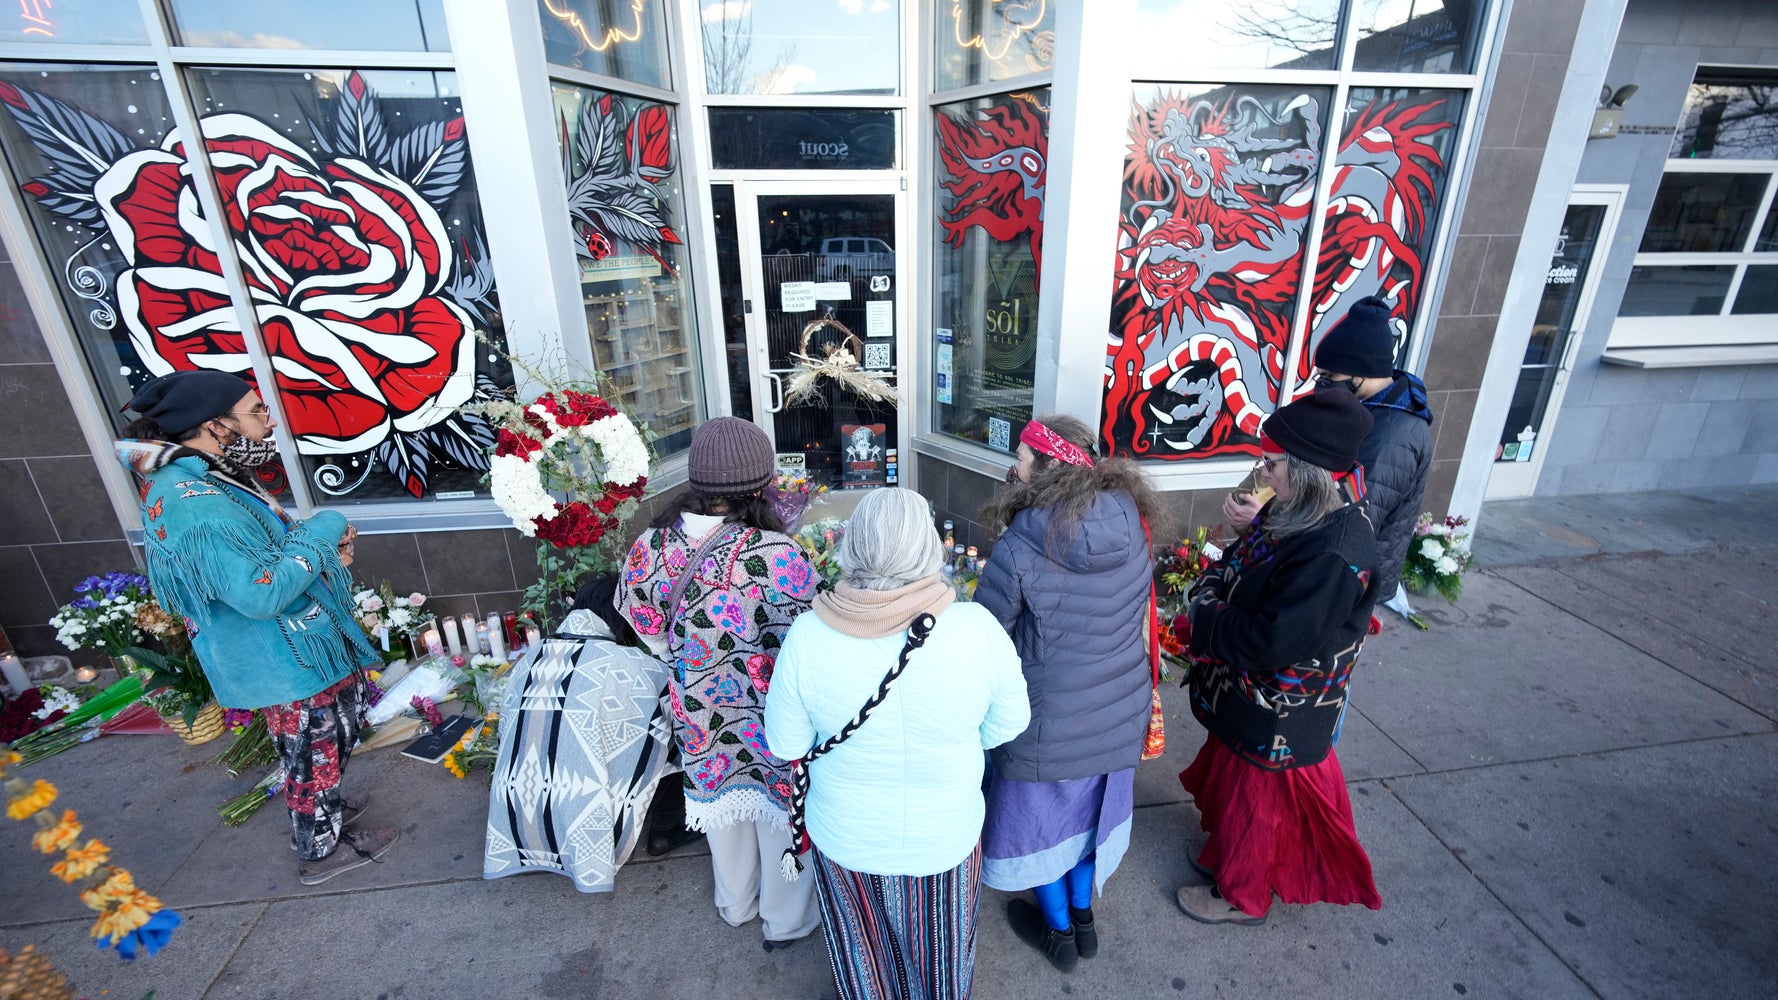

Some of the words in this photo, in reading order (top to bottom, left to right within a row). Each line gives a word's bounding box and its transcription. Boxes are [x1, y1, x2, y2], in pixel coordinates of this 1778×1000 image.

[587, 261, 602, 269] WE
[604, 259, 620, 268] THE
[621, 257, 650, 266] PEOPLE
[1548, 264, 1577, 278] ction
[786, 456, 803, 464] APP
